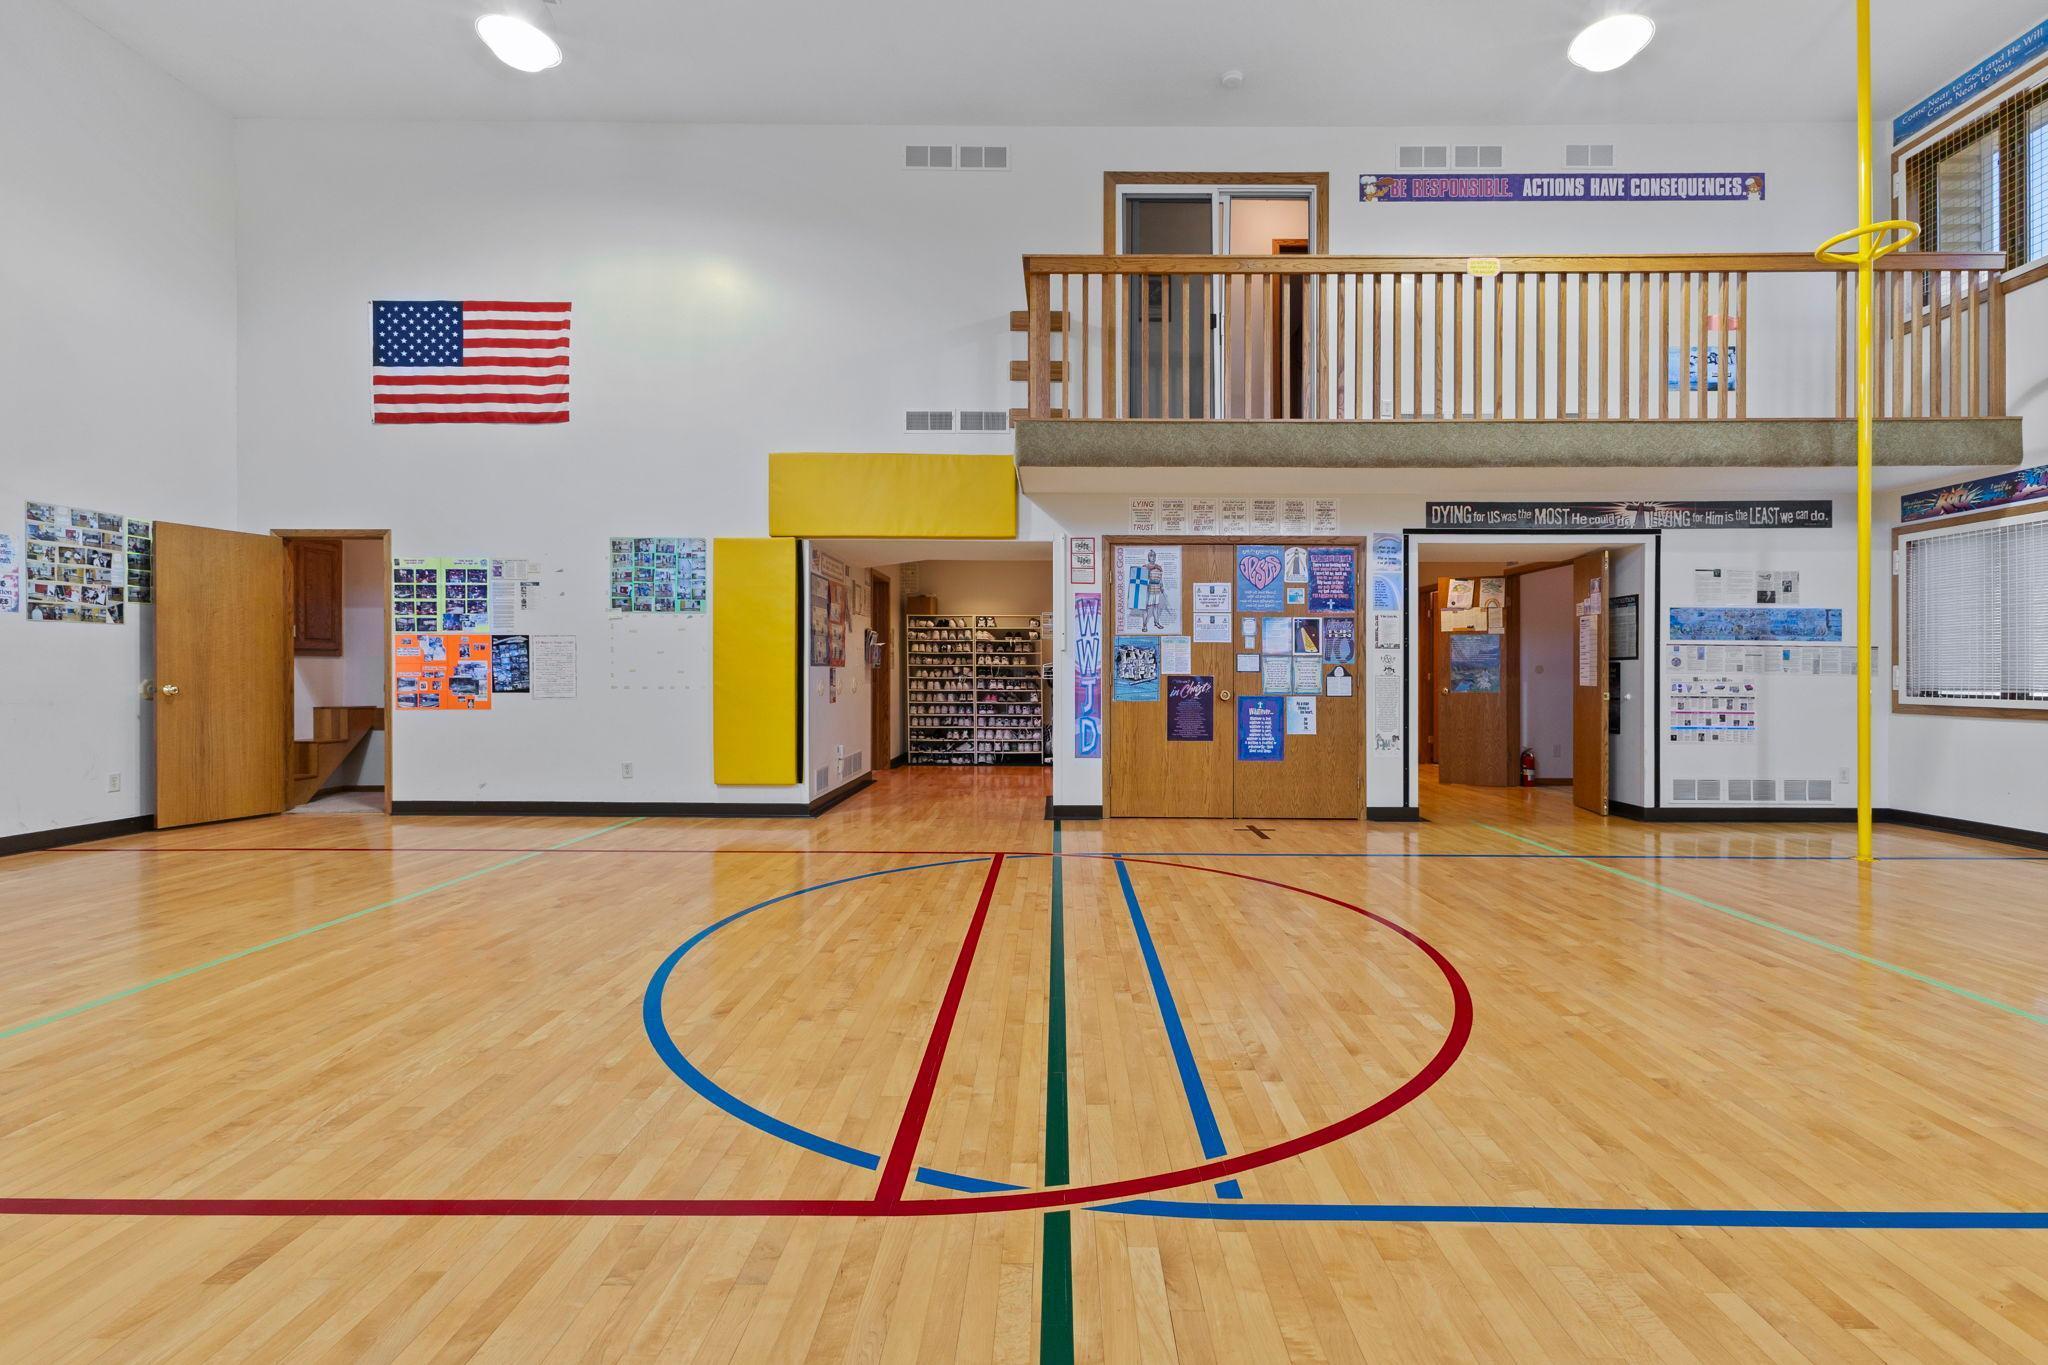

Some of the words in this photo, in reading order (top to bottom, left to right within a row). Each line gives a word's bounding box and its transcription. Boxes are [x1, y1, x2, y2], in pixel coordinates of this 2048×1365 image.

[1902, 105, 1925, 125] Come
[1928, 90, 1950, 108] Near
[1952, 82, 1962, 92] to
[1964, 66, 1983, 84] God
[1985, 53, 2005, 71] and
[2007, 43, 2021, 57] He
[2023, 27, 2044, 46] Will
[1927, 97, 1953, 117] Come
[1955, 81, 1979, 99] Near
[1980, 73, 1991, 84] to
[1390, 178, 1407, 198] BE
[1412, 177, 1513, 198] RESPONSIBLE.
[1522, 177, 1585, 197] ACTIONS
[1590, 177, 1625, 197] HAVE
[1630, 177, 1747, 199] CONSEQUENCES.
[1431, 505, 1472, 524] DYING
[1473, 511, 1486, 522] for
[1487, 511, 1500, 524] US
[1501, 513, 1516, 522] was
[1517, 509, 1532, 519] the
[1534, 508, 1571, 525] MOST
[1571, 513, 1588, 525] He
[1588, 513, 1615, 525] could
[1692, 512, 1704, 522] for
[1705, 513, 1724, 525] Him
[1724, 512, 1734, 522] is
[1735, 509, 1748, 520] the
[1749, 507, 1780, 525] LEAST
[1780, 513, 1794, 524] we
[1795, 510, 1808, 520] can
[1810, 510, 1829, 521] do.
